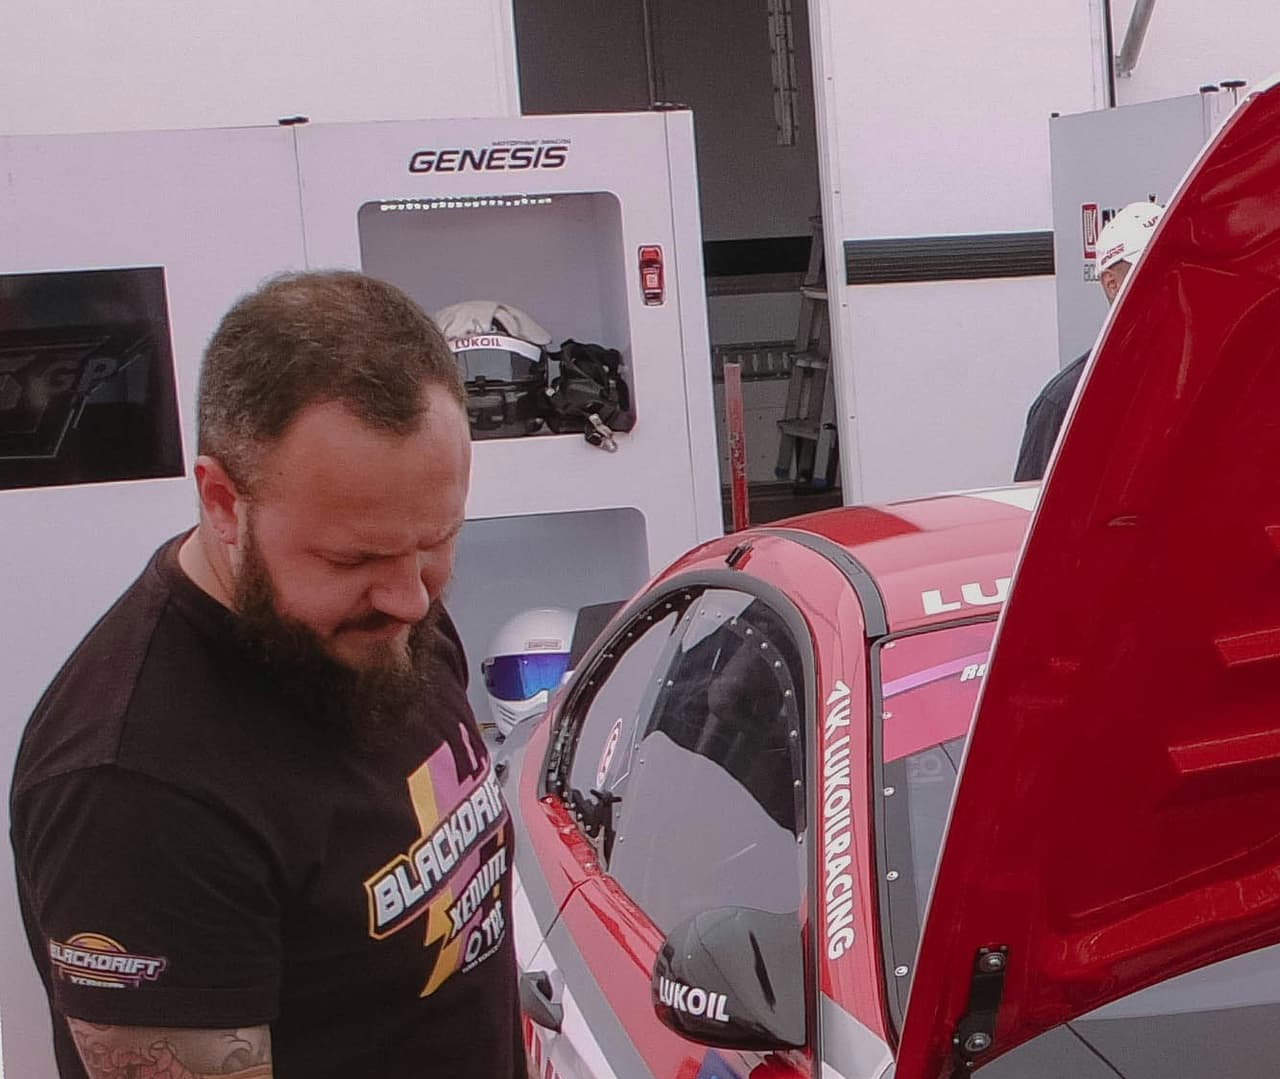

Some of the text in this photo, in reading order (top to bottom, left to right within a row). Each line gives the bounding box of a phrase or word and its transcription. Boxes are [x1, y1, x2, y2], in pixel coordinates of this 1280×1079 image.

[408, 146, 569, 173] GENESIS
[455, 338, 501, 349] LUKOIL
[823, 734, 855, 960] LUKOILRACING
[659, 976, 730, 1023] LUKOIL
